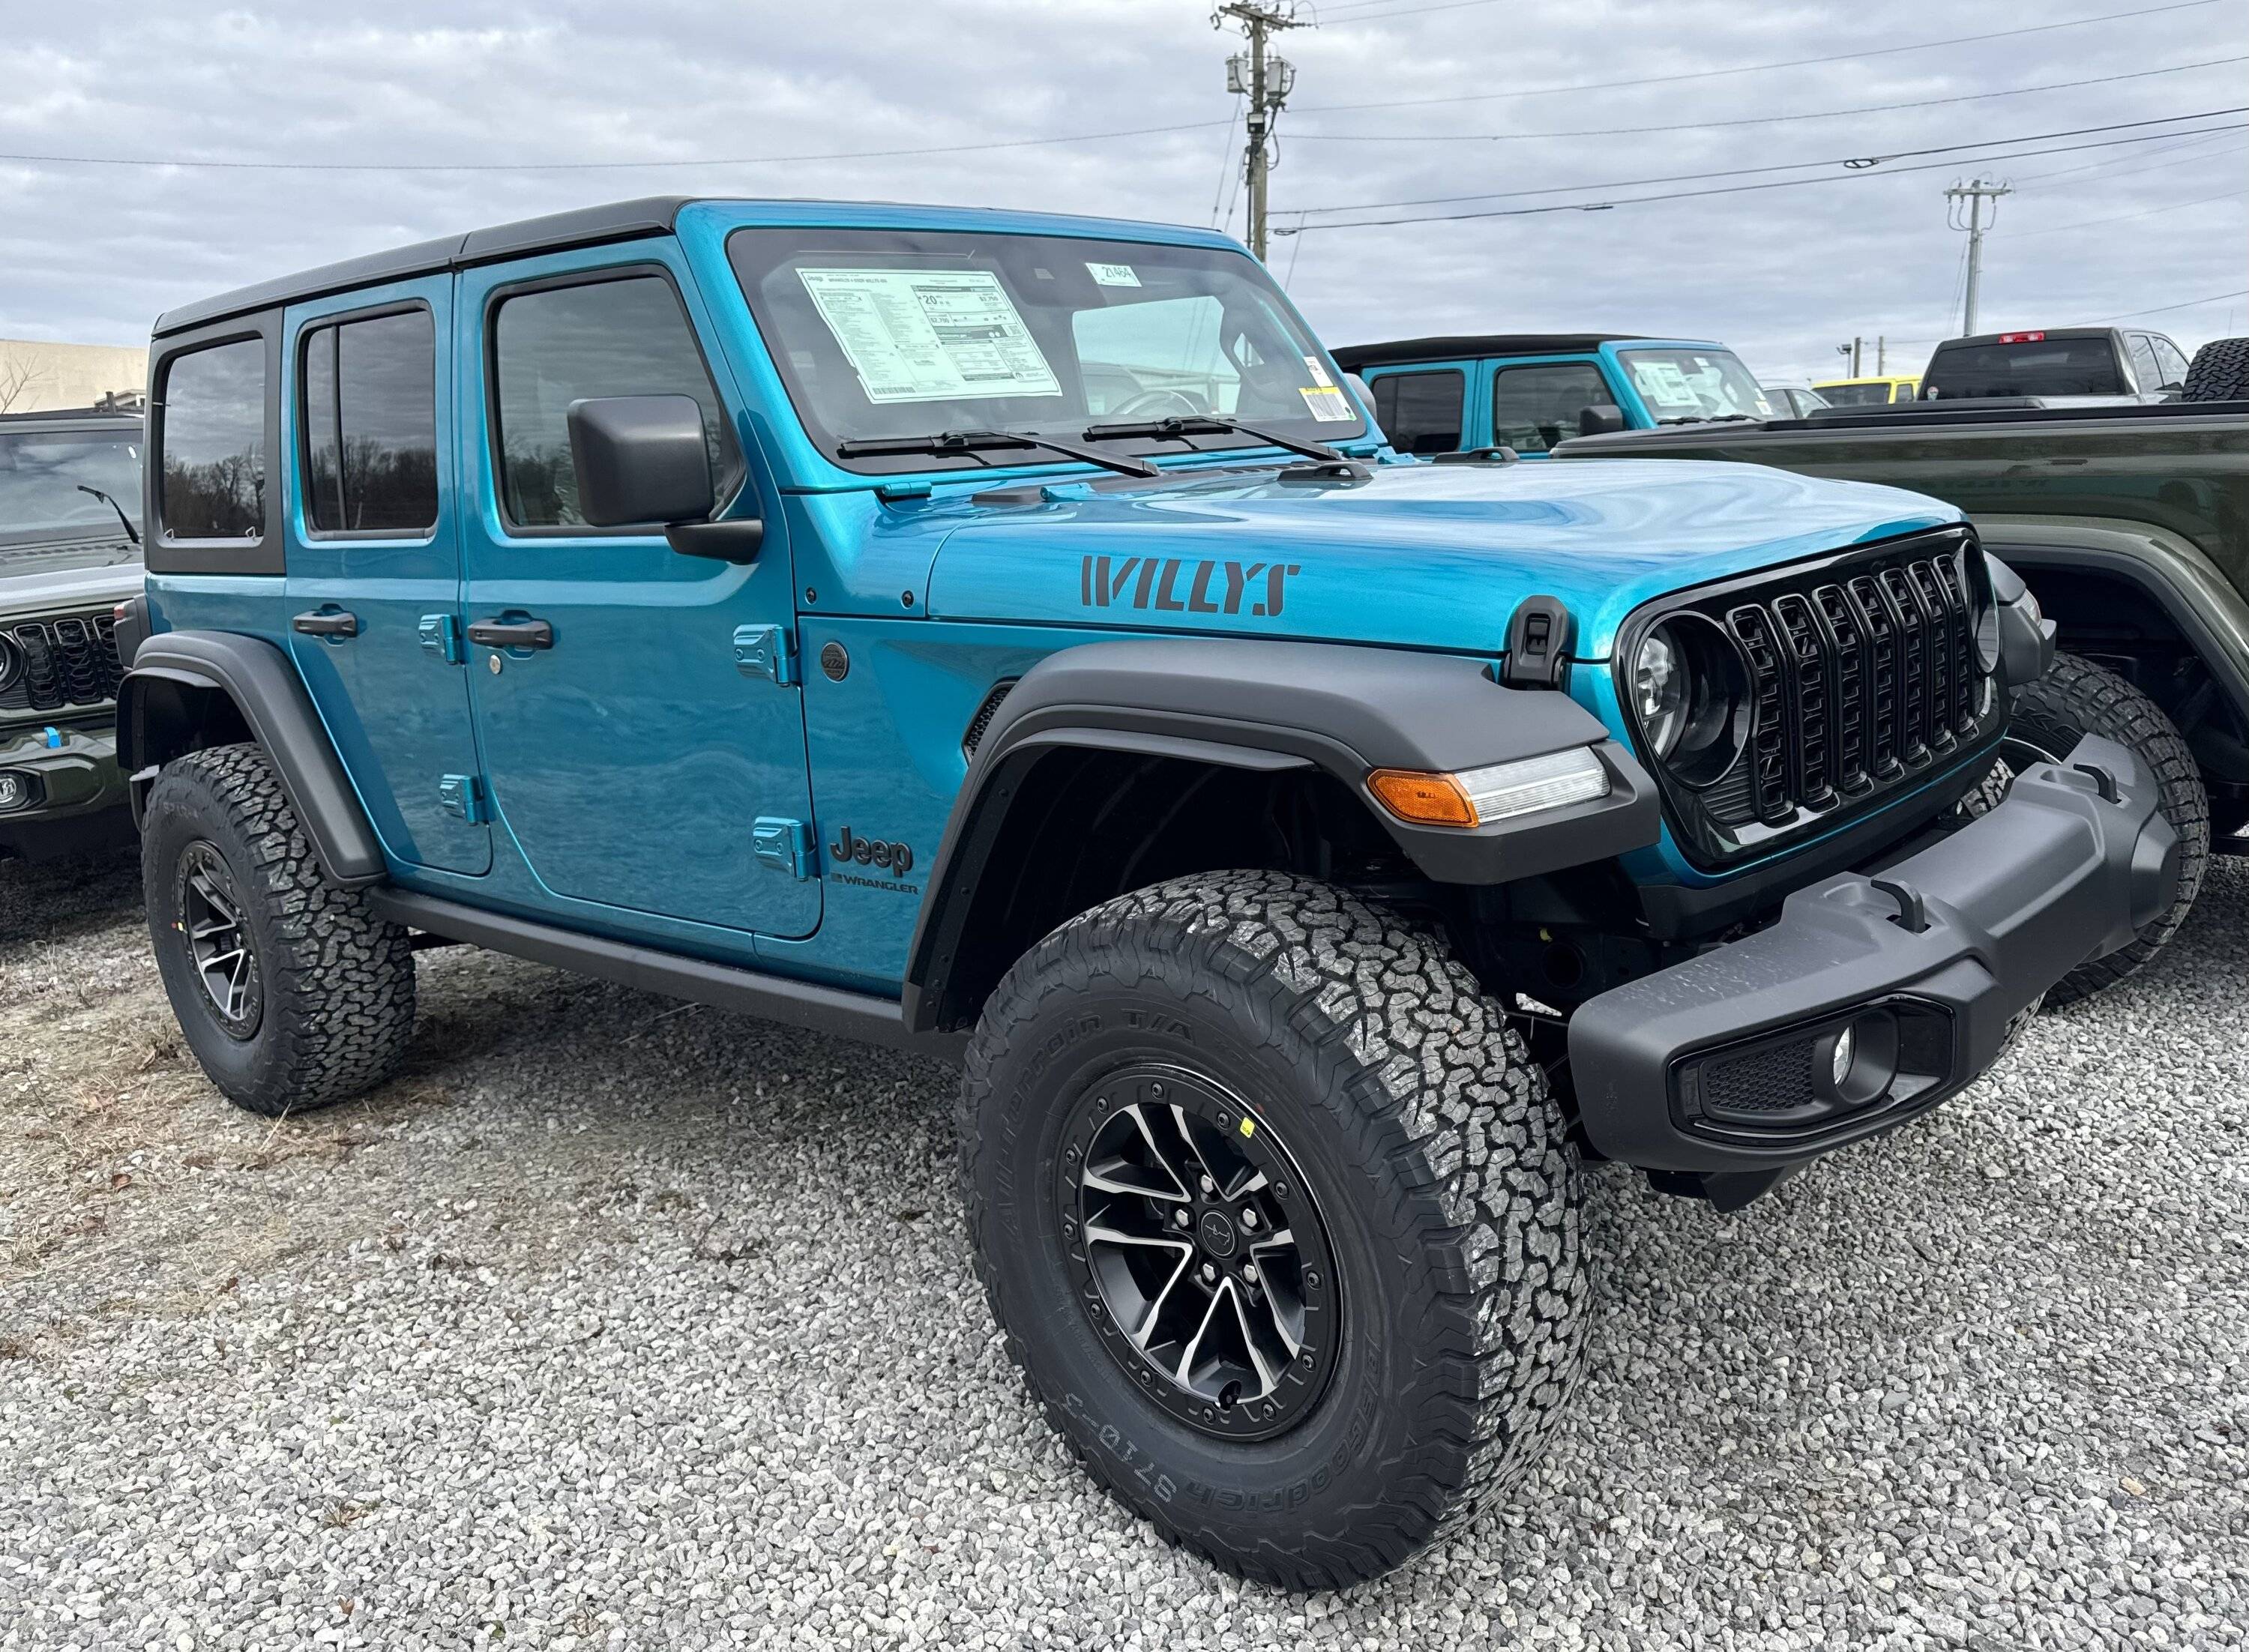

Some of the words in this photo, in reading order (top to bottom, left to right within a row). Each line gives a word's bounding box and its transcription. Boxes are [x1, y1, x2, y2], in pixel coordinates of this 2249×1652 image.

[923, 295, 937, 304] 20
[1082, 555, 1301, 617] WILLYS
[830, 825, 914, 878] Jeep
[843, 874, 918, 895] WRANGLER
